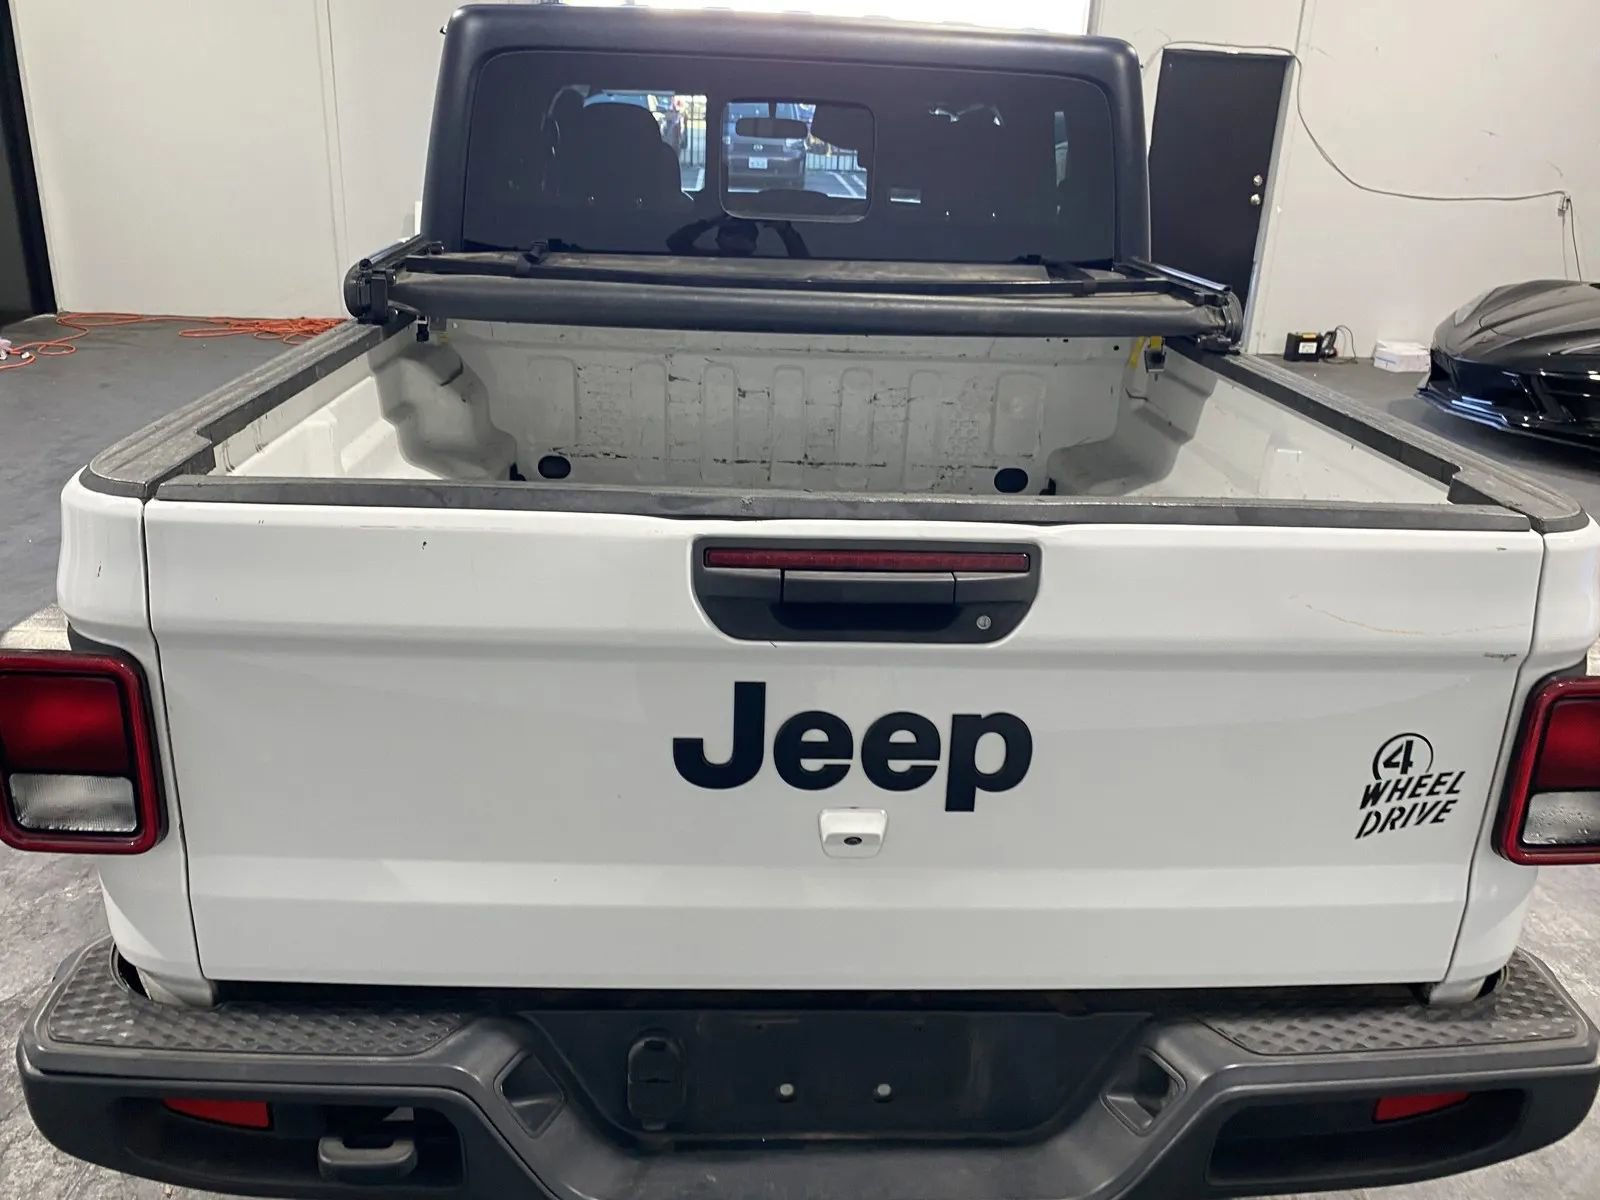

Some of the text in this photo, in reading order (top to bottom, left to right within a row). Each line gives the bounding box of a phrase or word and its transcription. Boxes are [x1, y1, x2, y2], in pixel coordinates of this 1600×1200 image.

[673, 681, 1033, 812] Jeep
[1382, 739, 1414, 775] 4
[1359, 770, 1466, 810] WHEEL
[1355, 798, 1458, 840] DRIVE
